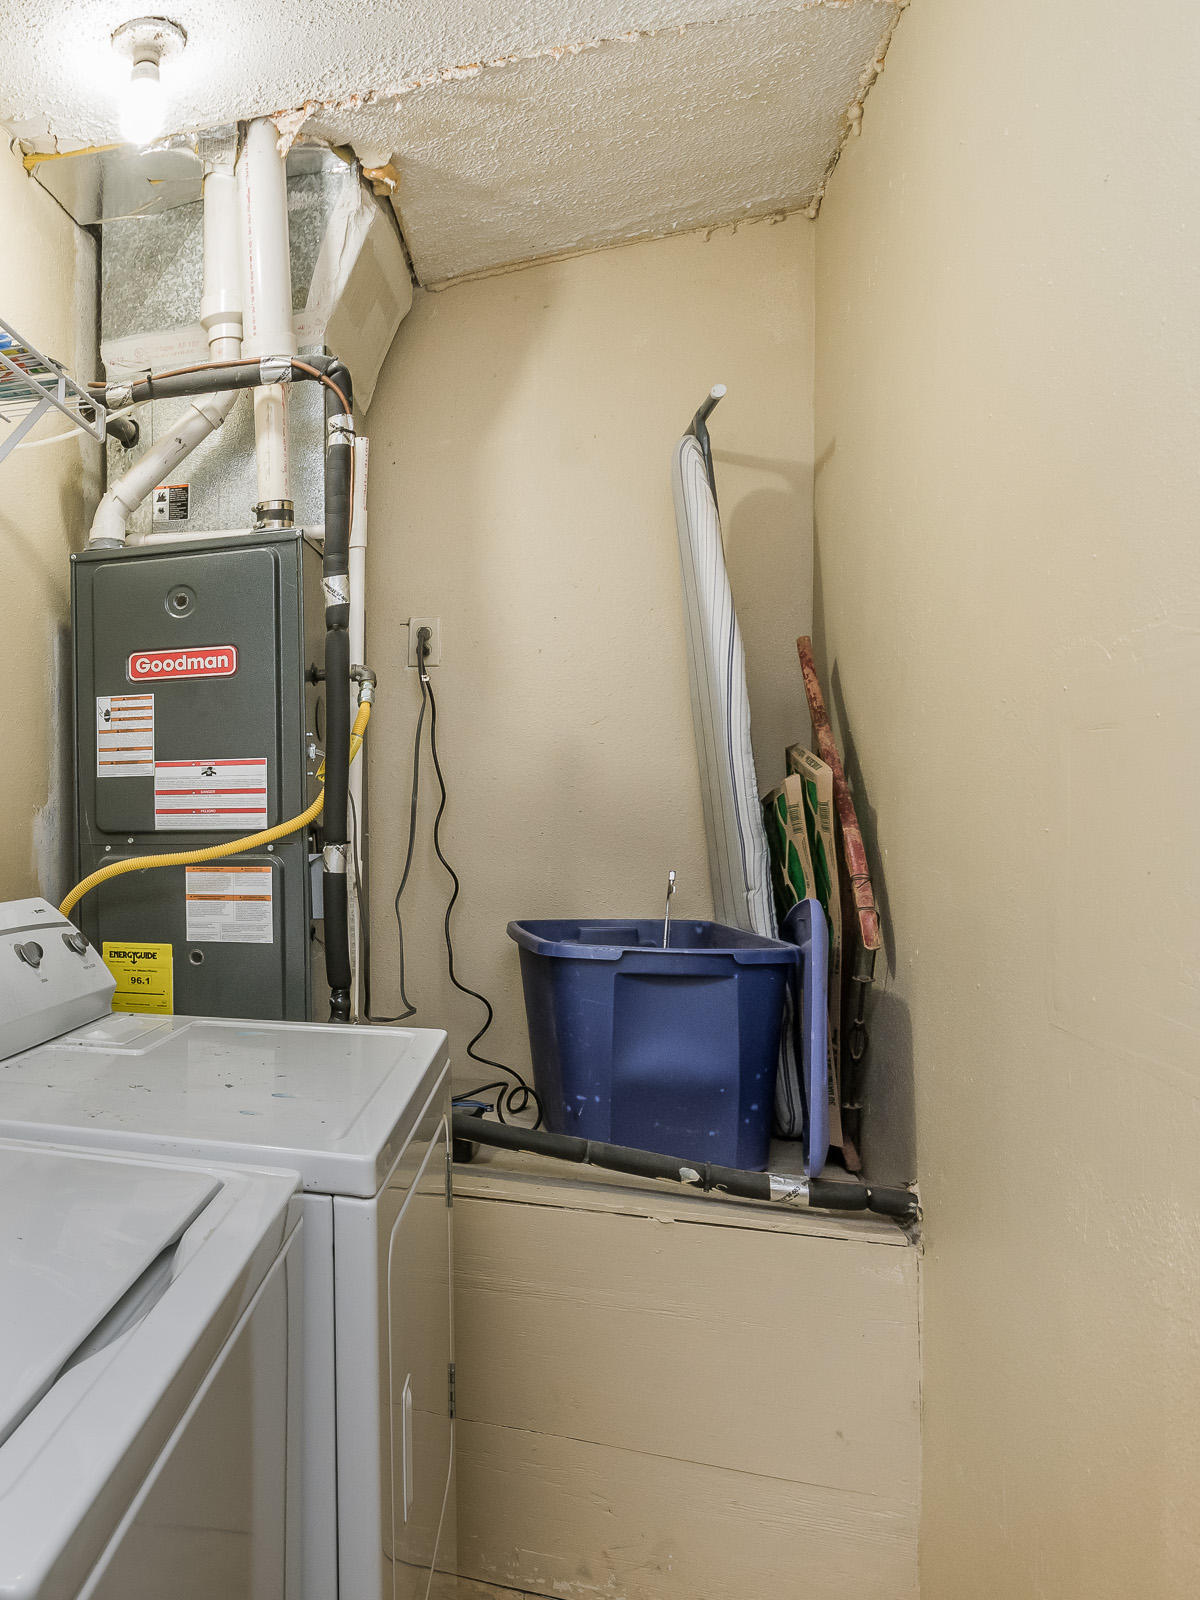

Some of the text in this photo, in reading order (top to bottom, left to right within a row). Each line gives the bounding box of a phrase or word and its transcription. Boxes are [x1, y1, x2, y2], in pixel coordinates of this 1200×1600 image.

[135, 655, 229, 674] Goodman
[109, 951, 158, 962] ENERGYGUIDE
[130, 976, 150, 985] 96.1
